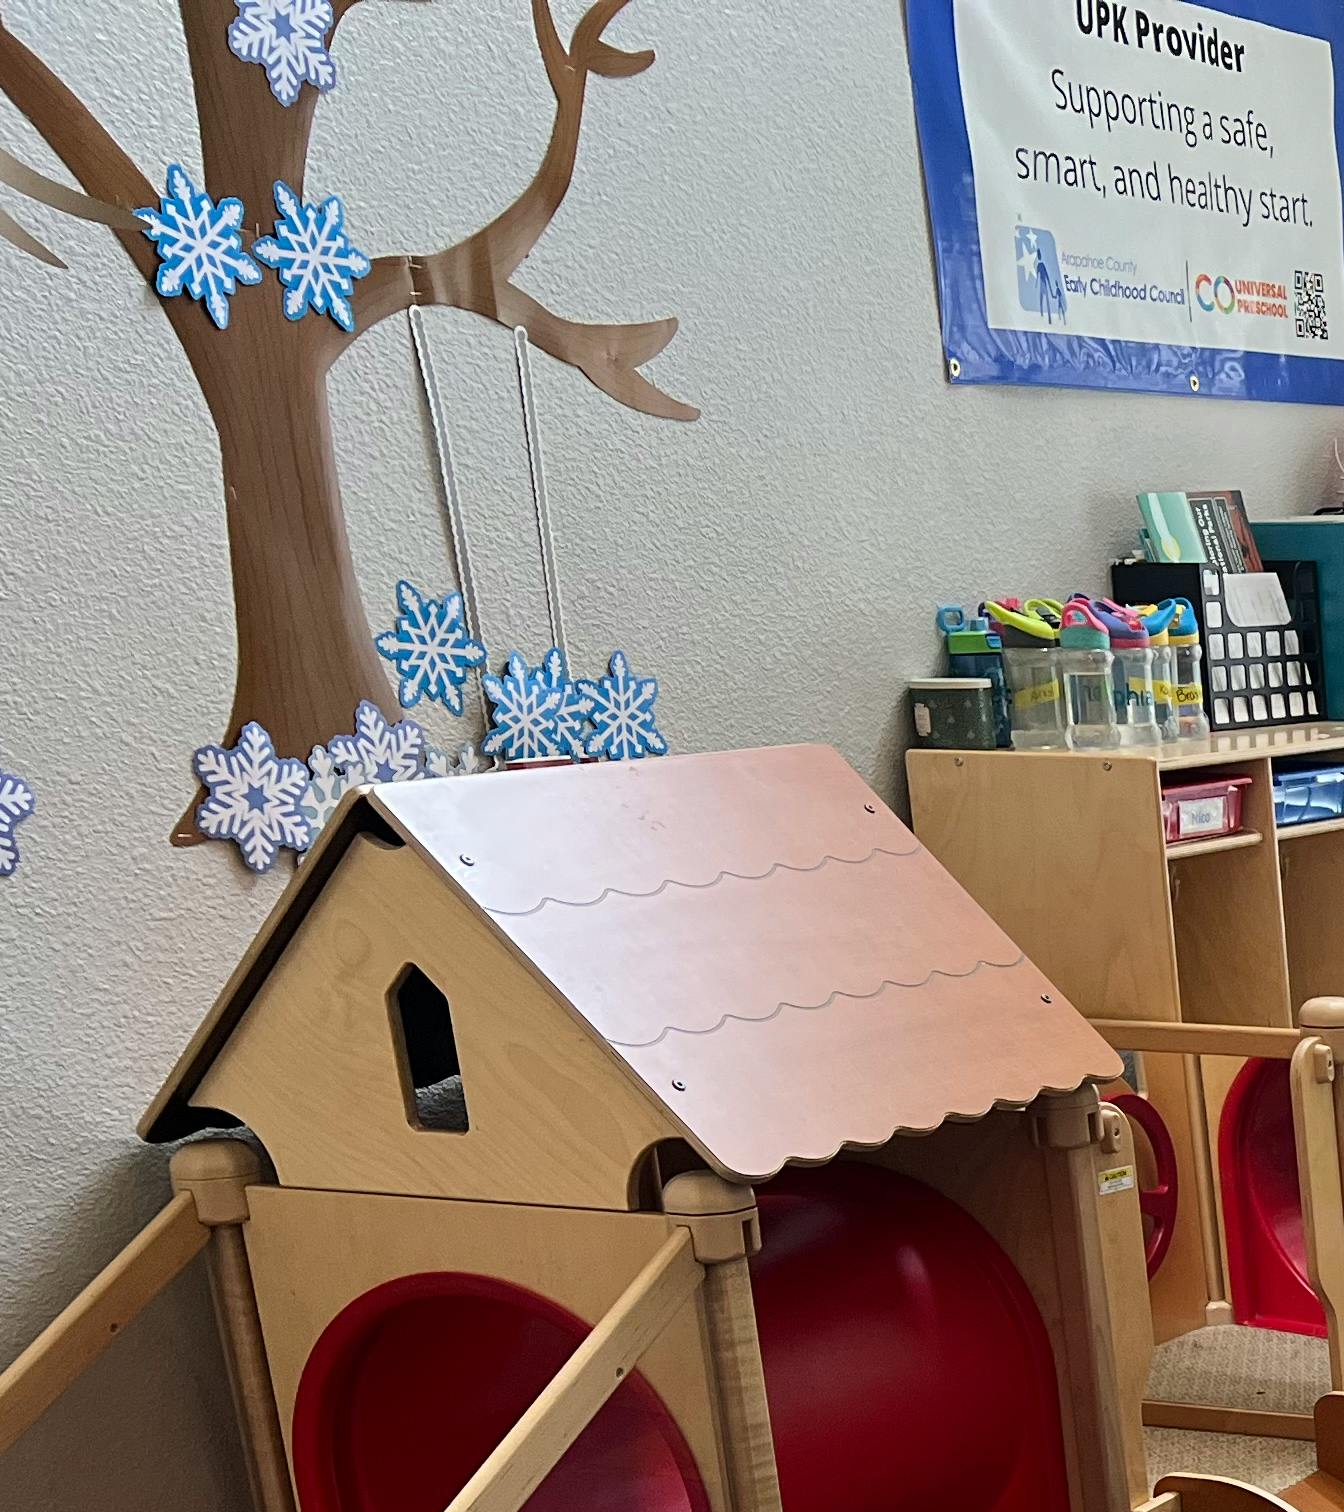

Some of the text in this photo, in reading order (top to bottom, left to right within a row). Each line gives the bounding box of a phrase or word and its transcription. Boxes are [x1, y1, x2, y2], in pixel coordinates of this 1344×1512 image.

[1076, 0, 1246, 73] UPK Provider
[1051, 68, 1275, 158] Supporting a safe,
[1016, 145, 1314, 229] smart, and healthy start.
[1061, 251, 1138, 277] Arapahoe County
[1063, 274, 1186, 306] Early Childhood Council
[1195, 273, 1236, 315] CO
[1235, 279, 1289, 301] UNIVERSAL
[1237, 301, 1289, 319] PRESCHOOL
[1211, 536, 1228, 574] ational
